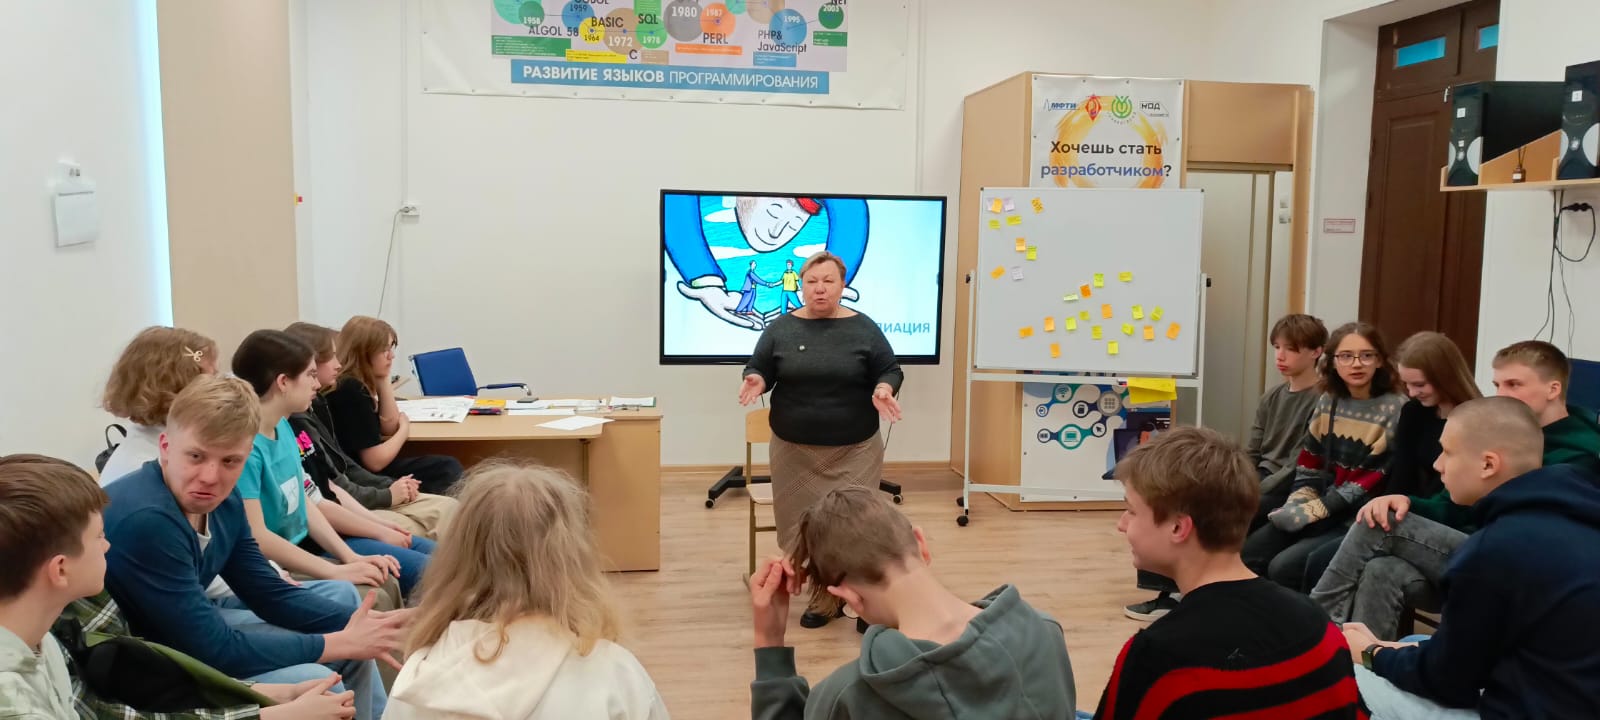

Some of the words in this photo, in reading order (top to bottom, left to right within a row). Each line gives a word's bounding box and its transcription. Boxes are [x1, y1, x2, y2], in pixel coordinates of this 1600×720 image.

[671, 6, 698, 17] 1980
[591, 16, 624, 28] BASIC
[638, 13, 659, 25] SQL
[528, 25, 562, 36] ALGOL
[567, 26, 579, 37] 58
[758, 30, 783, 40] PHP&
[584, 34, 600, 42] 1964
[609, 36, 633, 47] 1972
[703, 32, 729, 45] PERL
[757, 41, 807, 55] JavaScript
[629, 49, 638, 60] C
[523, 65, 598, 80] РАЗВИТИЕ
[603, 69, 665, 83] ЯЗЫКОВ
[669, 71, 818, 89] ПРОГРАММИРОВАНИЯ
[1050, 140, 1114, 154] Хочешь
[1118, 144, 1162, 155] стать
[1040, 162, 1172, 179] разработчиком?
